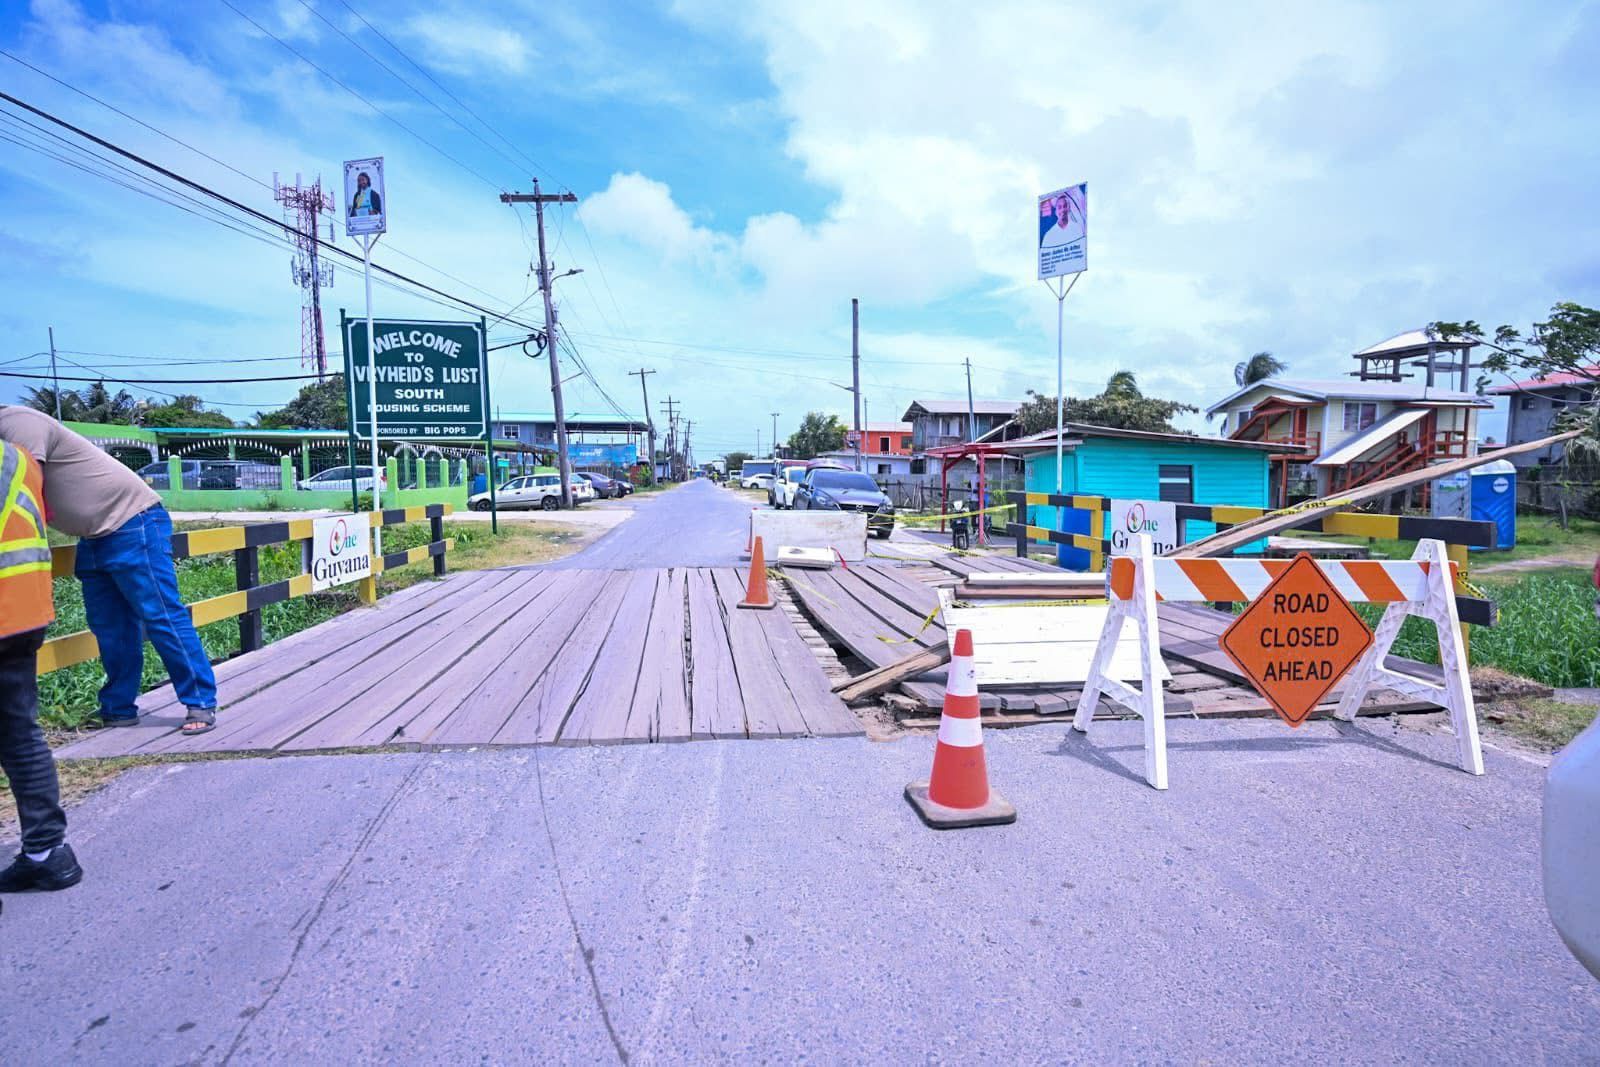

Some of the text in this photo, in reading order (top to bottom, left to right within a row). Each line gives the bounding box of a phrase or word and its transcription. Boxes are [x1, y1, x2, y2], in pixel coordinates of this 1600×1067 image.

[372, 330, 462, 359] WELCOME
[404, 352, 424, 363] TO
[442, 367, 478, 384] LUST
[394, 388, 444, 399] SOUTH
[423, 404, 471, 413] SCHEME
[424, 426, 440, 434] BIG
[443, 426, 467, 435] POPS
[1127, 503, 1158, 534] One
[330, 519, 357, 556] One
[314, 554, 369, 583] Guyana
[1273, 593, 1329, 614] ROAD
[1260, 626, 1339, 648] CLOSED
[1263, 660, 1333, 682] AHEAD
